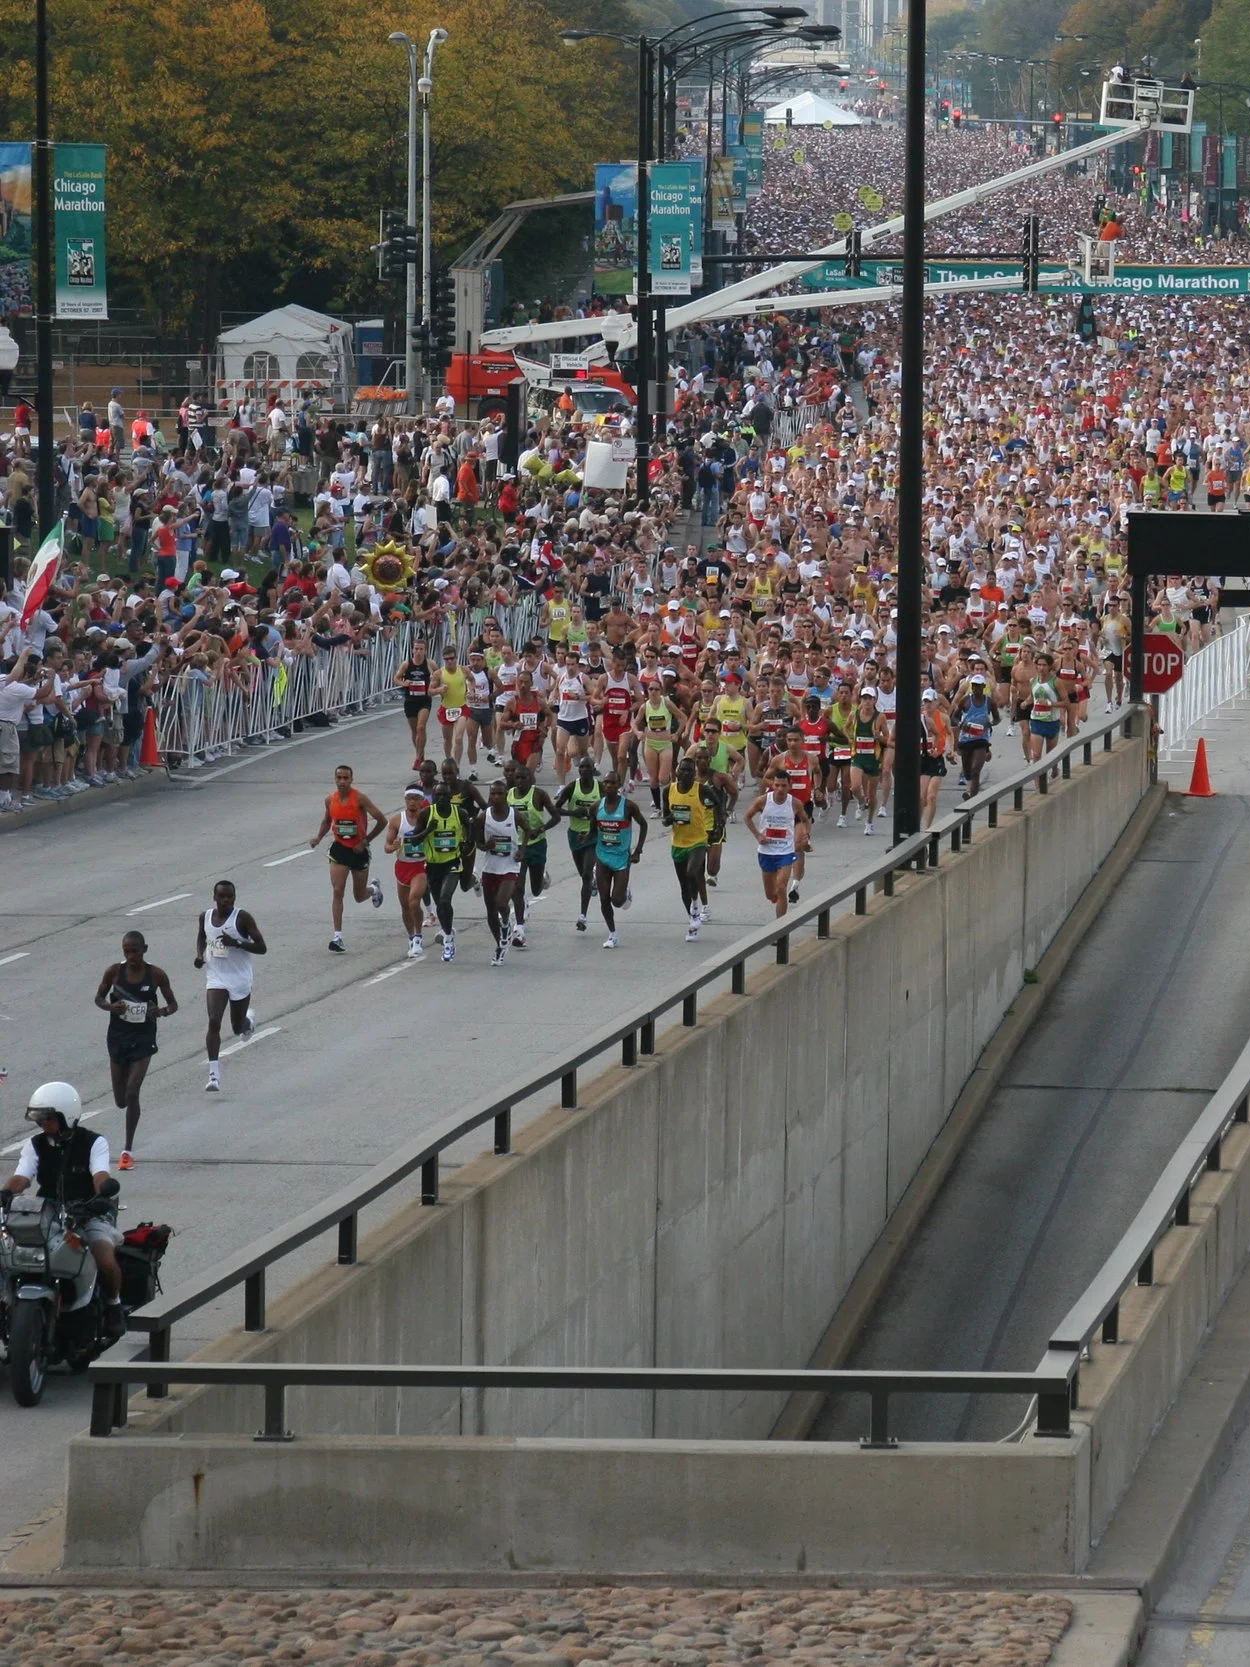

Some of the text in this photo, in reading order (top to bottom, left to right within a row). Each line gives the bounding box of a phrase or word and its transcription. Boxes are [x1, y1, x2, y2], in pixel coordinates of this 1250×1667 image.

[54, 178, 96, 196] Chicago
[650, 190, 683, 203] Chicago
[54, 196, 105, 212] Marathon
[650, 204, 690, 215] Marathon
[825, 269, 847, 277] LaSall
[936, 270, 969, 283] The
[1158, 274, 1240, 289] Marathon
[126, 1003, 146, 1016] ACER
